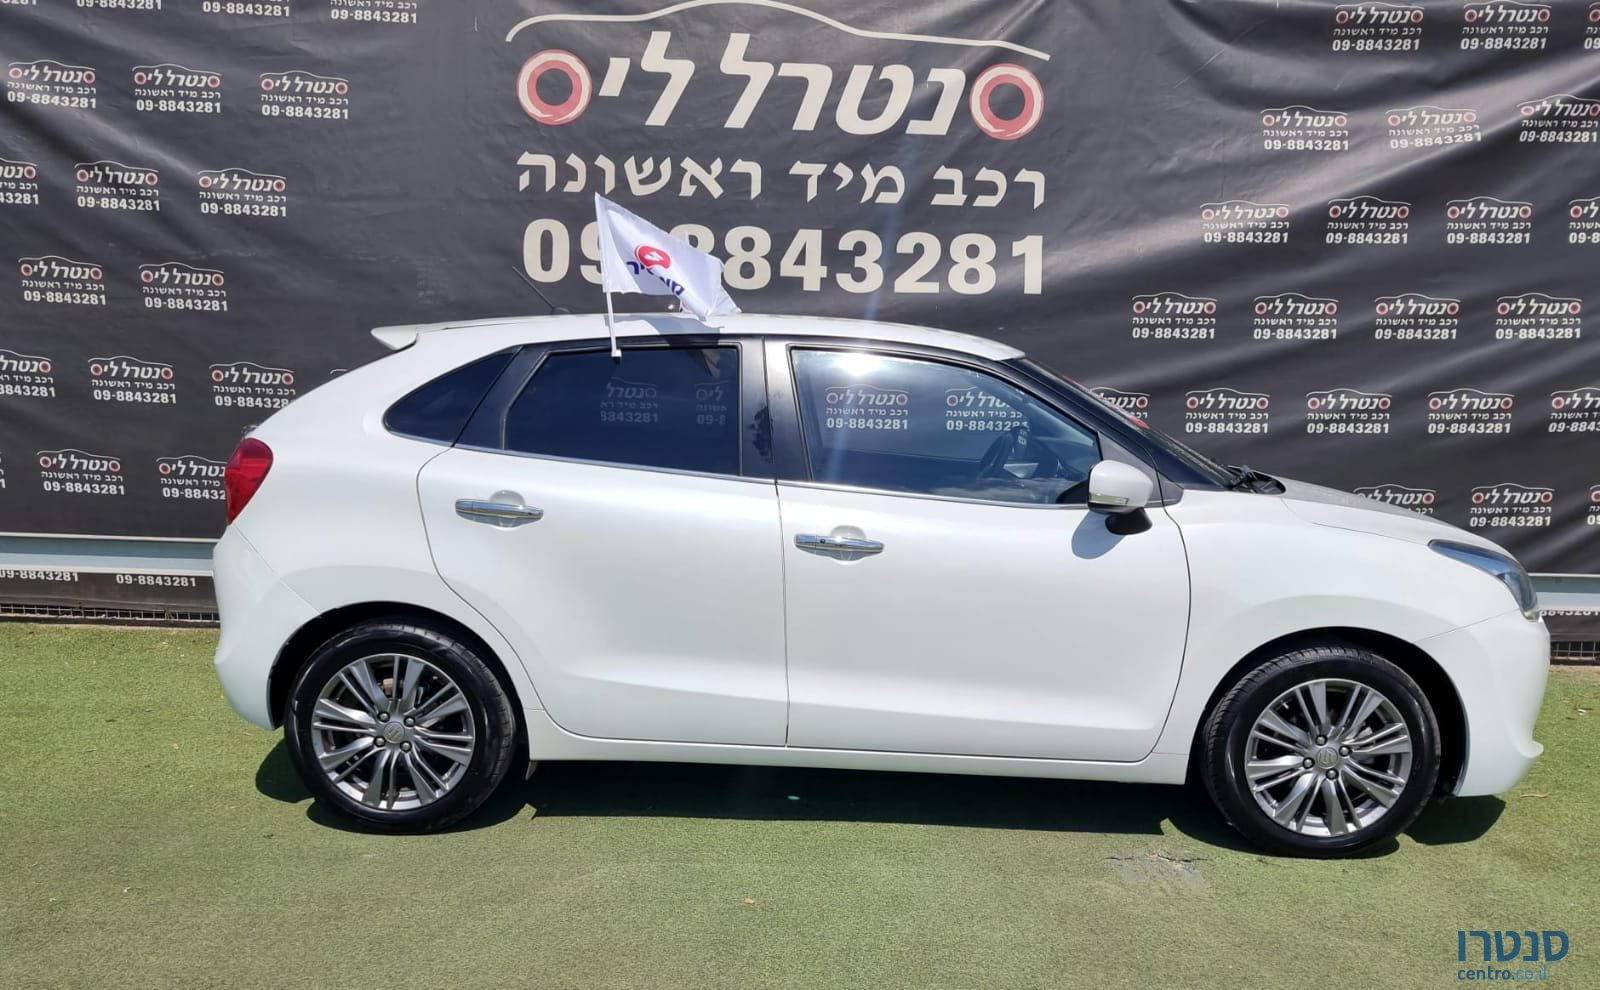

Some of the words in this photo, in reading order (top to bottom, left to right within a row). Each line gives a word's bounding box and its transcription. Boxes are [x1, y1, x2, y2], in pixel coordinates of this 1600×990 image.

[202, 1, 290, 17] 09-8843281
[330, 8, 417, 24] 09-8843281
[1332, 38, 1420, 51] 09-8843281
[1461, 37, 1547, 50] 09-8843281
[8, 92, 96, 108] 09-8843281
[135, 98, 221, 114] 09-8843281
[262, 104, 348, 120] 09-8843281
[1390, 133, 1481, 148] 09-8843281
[1519, 130, 1597, 143] 09-8843281
[1264, 139, 1349, 151] 09-8843281
[517, 152, 762, 200] ראשונה
[789, 161, 906, 204] מיד
[930, 166, 1046, 210] רכב
[79, 196, 161, 212] 09-8843281
[200, 202, 286, 217] 09-8843281
[1203, 231, 1290, 243] 09-8843281
[1326, 232, 1407, 244] 09-8843281
[1447, 232, 1531, 244] 09-8843281
[24, 290, 106, 306] 09-8843281
[144, 296, 227, 312] 09-8843281
[1132, 327, 1215, 339] 09-8843281
[1253, 328, 1336, 340] 09-8843281
[1374, 328, 1457, 340] 09-8843281
[1496, 327, 1580, 340] 09-8843281
[93, 389, 177, 404] 09-8843281
[826, 417, 908, 430] 09-8843281
[1185, 422, 1268, 434] 09-8843281
[1306, 422, 1389, 434] 09-8843281
[1427, 422, 1511, 434] 09-8843281
[43, 480, 125, 496] 09-8843281
[1469, 515, 1550, 527] 09-8843281
[116, 574, 196, 587] 09-8843281
